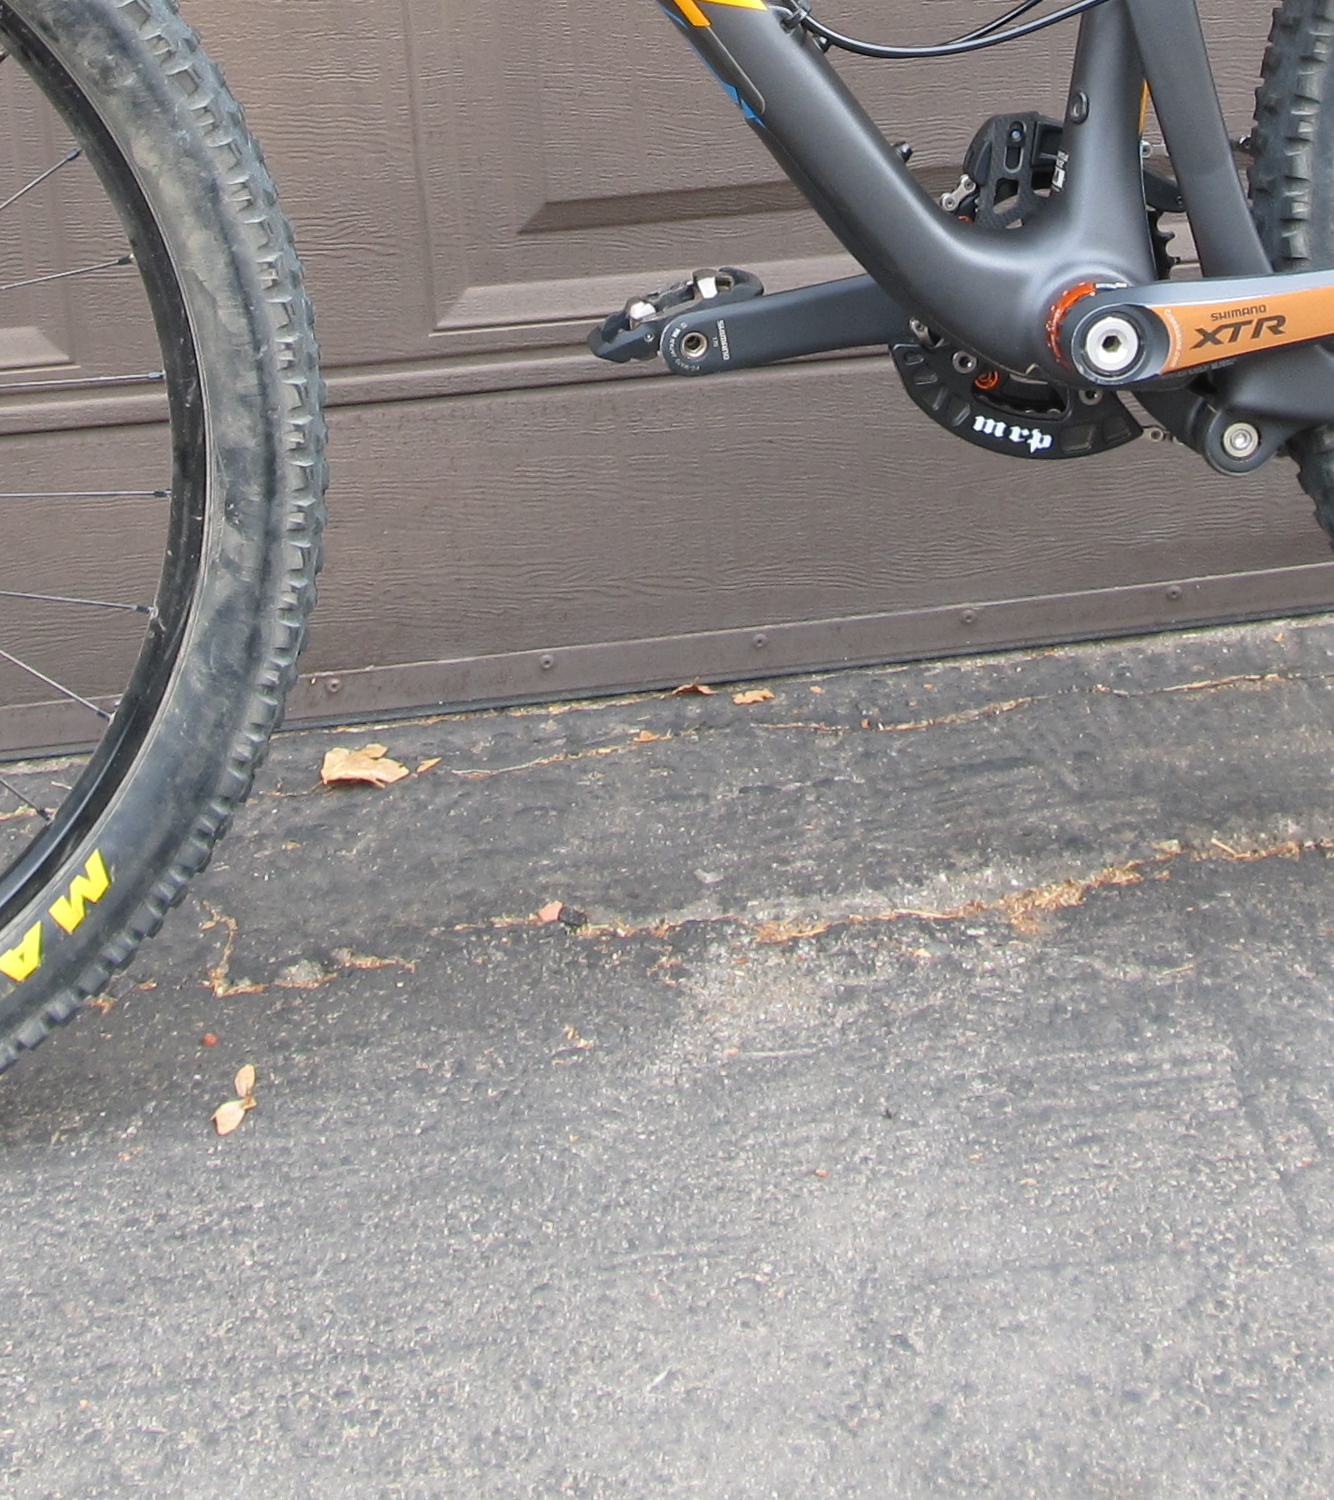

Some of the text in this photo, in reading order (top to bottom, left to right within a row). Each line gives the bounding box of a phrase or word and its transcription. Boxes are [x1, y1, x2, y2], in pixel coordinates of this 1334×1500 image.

[1210, 304, 1267, 322] SHIMANO
[1189, 314, 1287, 350] XTR
[972, 415, 1053, 454] mrp
